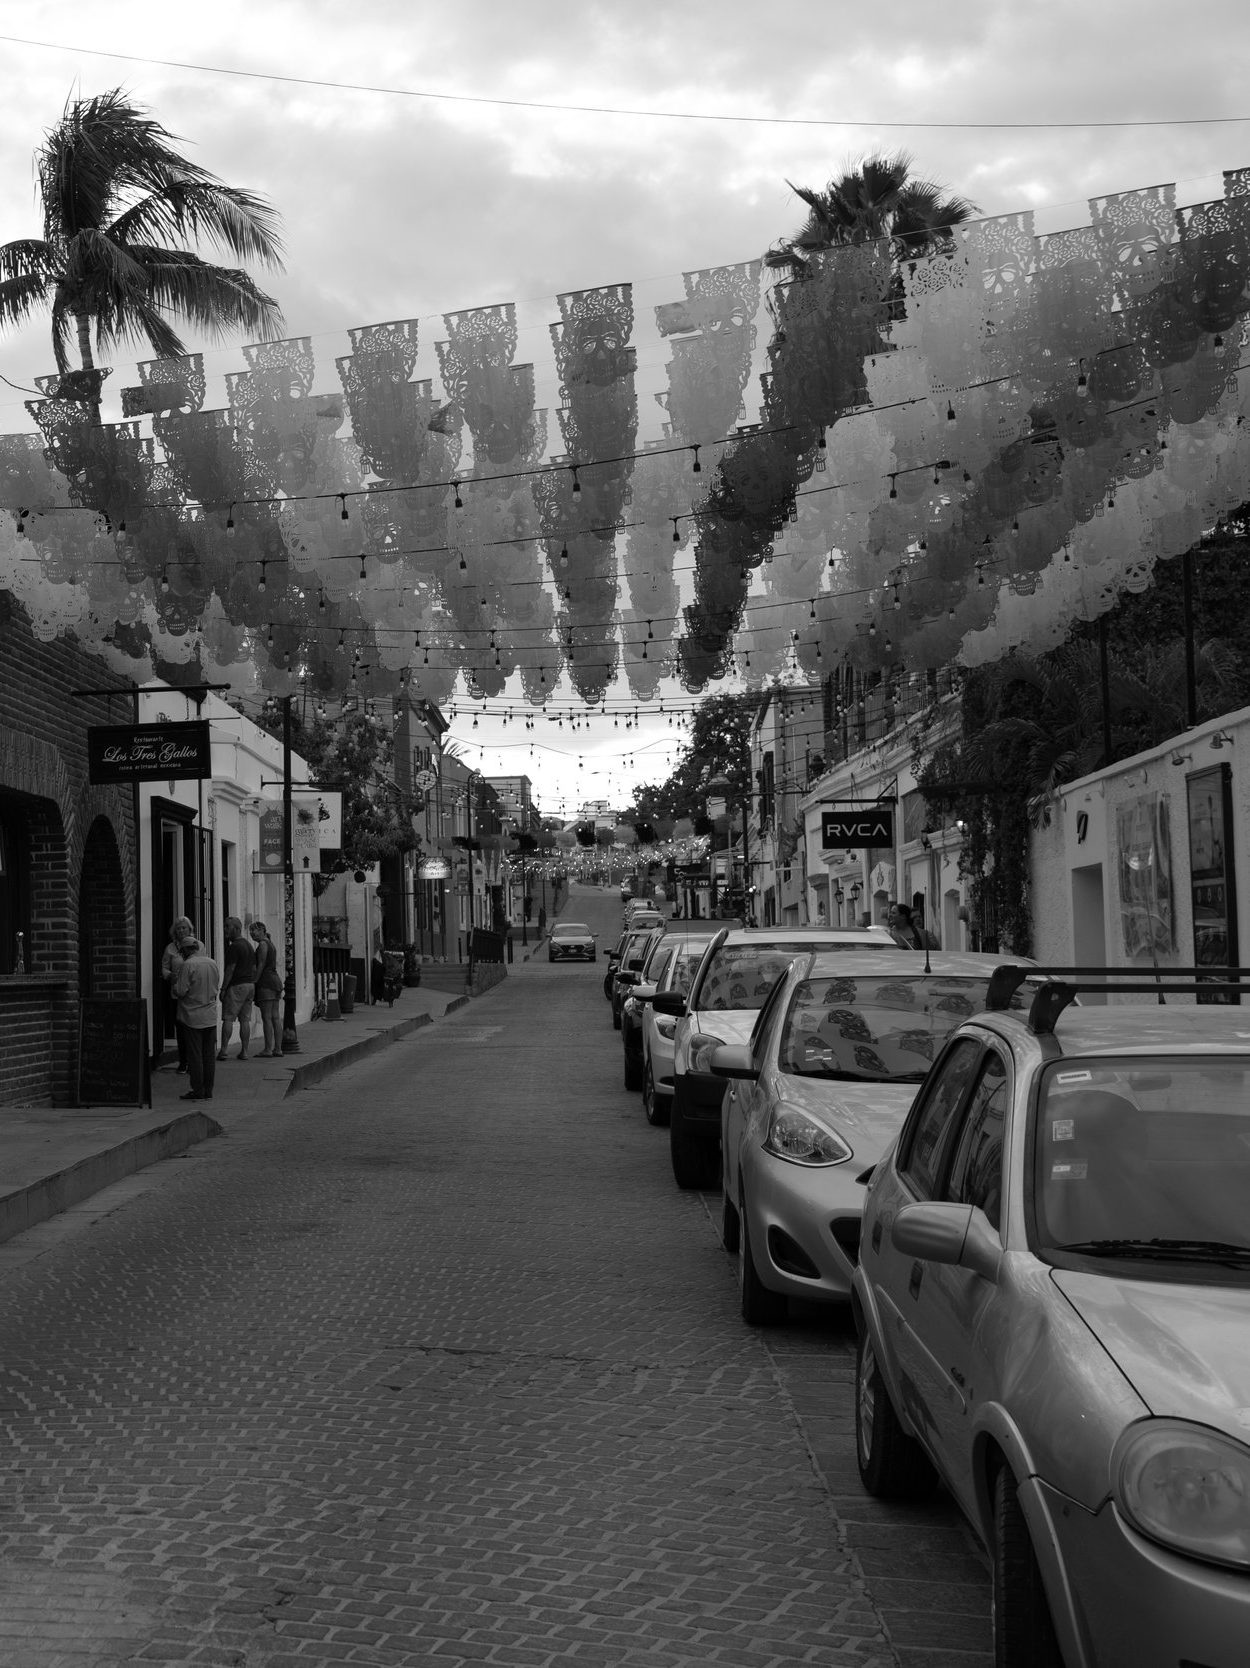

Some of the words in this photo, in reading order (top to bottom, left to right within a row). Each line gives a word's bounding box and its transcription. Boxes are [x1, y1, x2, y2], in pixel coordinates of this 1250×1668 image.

[102, 746, 127, 762] Los
[129, 744, 157, 761] Tres
[158, 742, 197, 762] Gallos
[826, 823, 888, 837] RVCA
